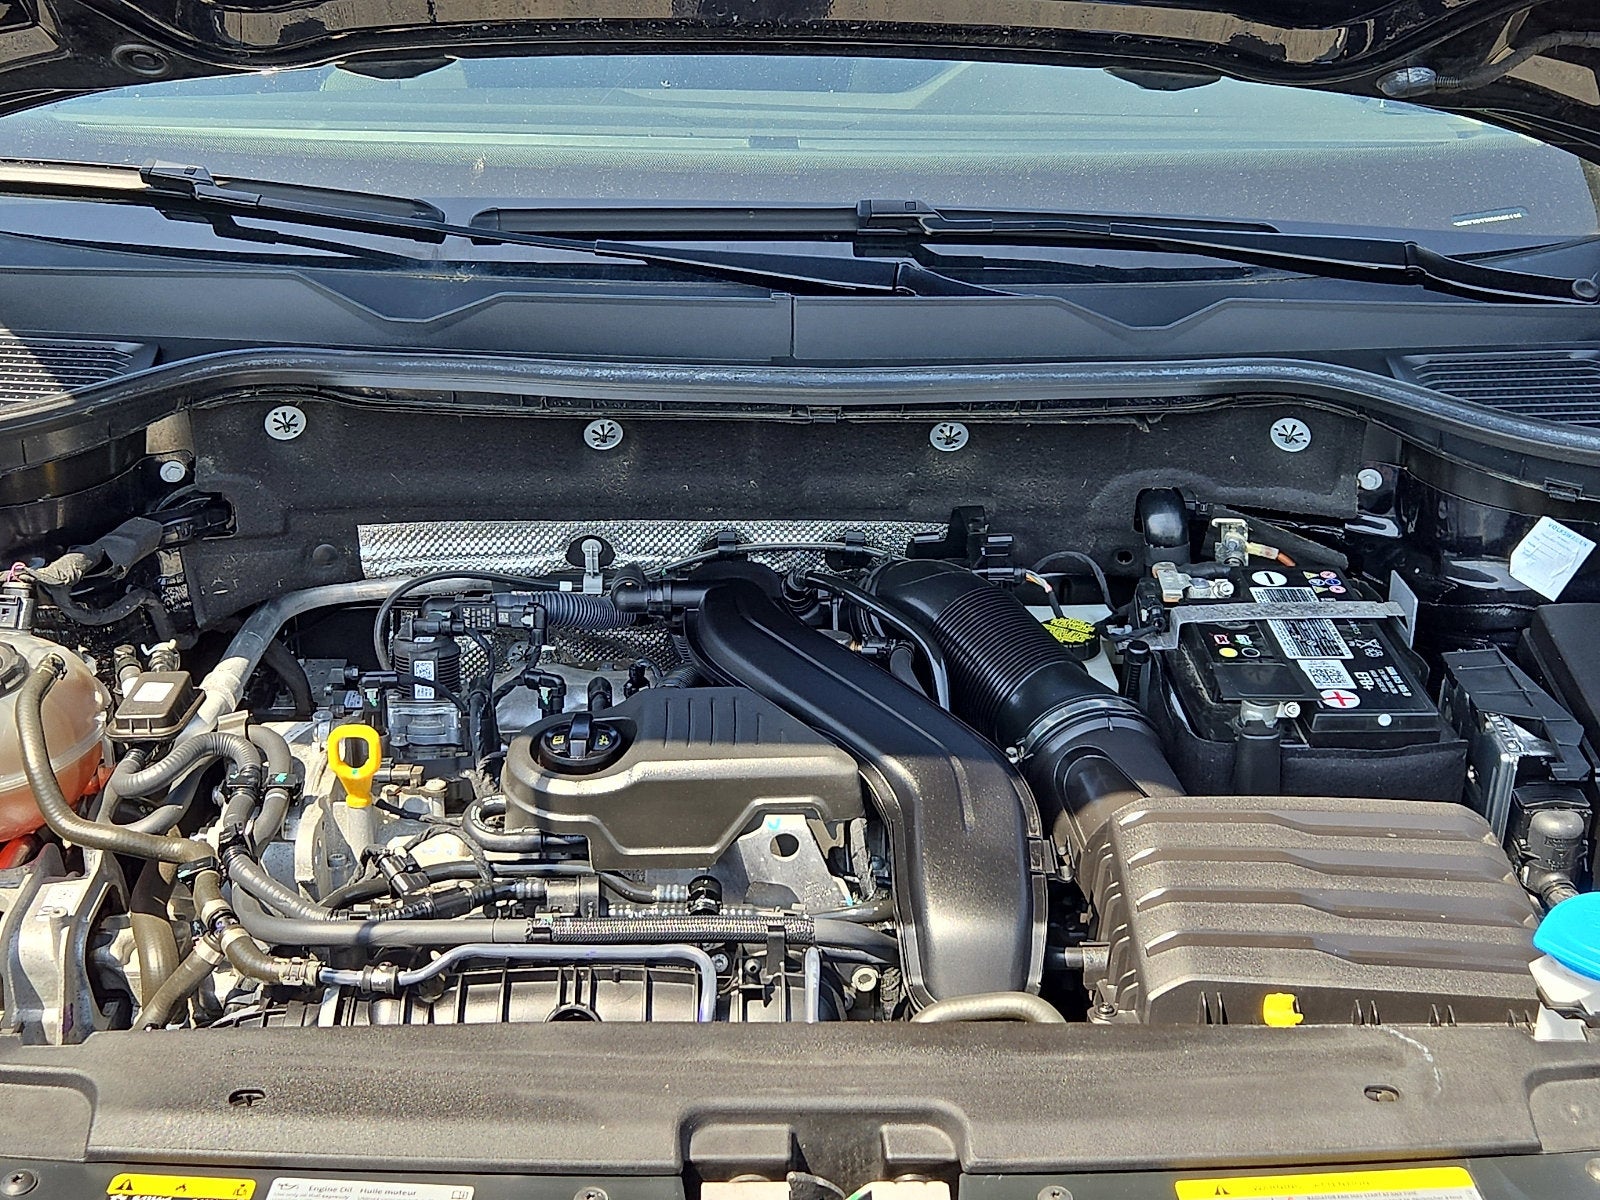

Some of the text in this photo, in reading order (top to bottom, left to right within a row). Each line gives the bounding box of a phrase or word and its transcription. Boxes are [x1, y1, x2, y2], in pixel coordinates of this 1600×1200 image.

[308, 1184, 338, 1193] Engine
[359, 1187, 383, 1195] Huile
[384, 1188, 417, 1196] moteur
